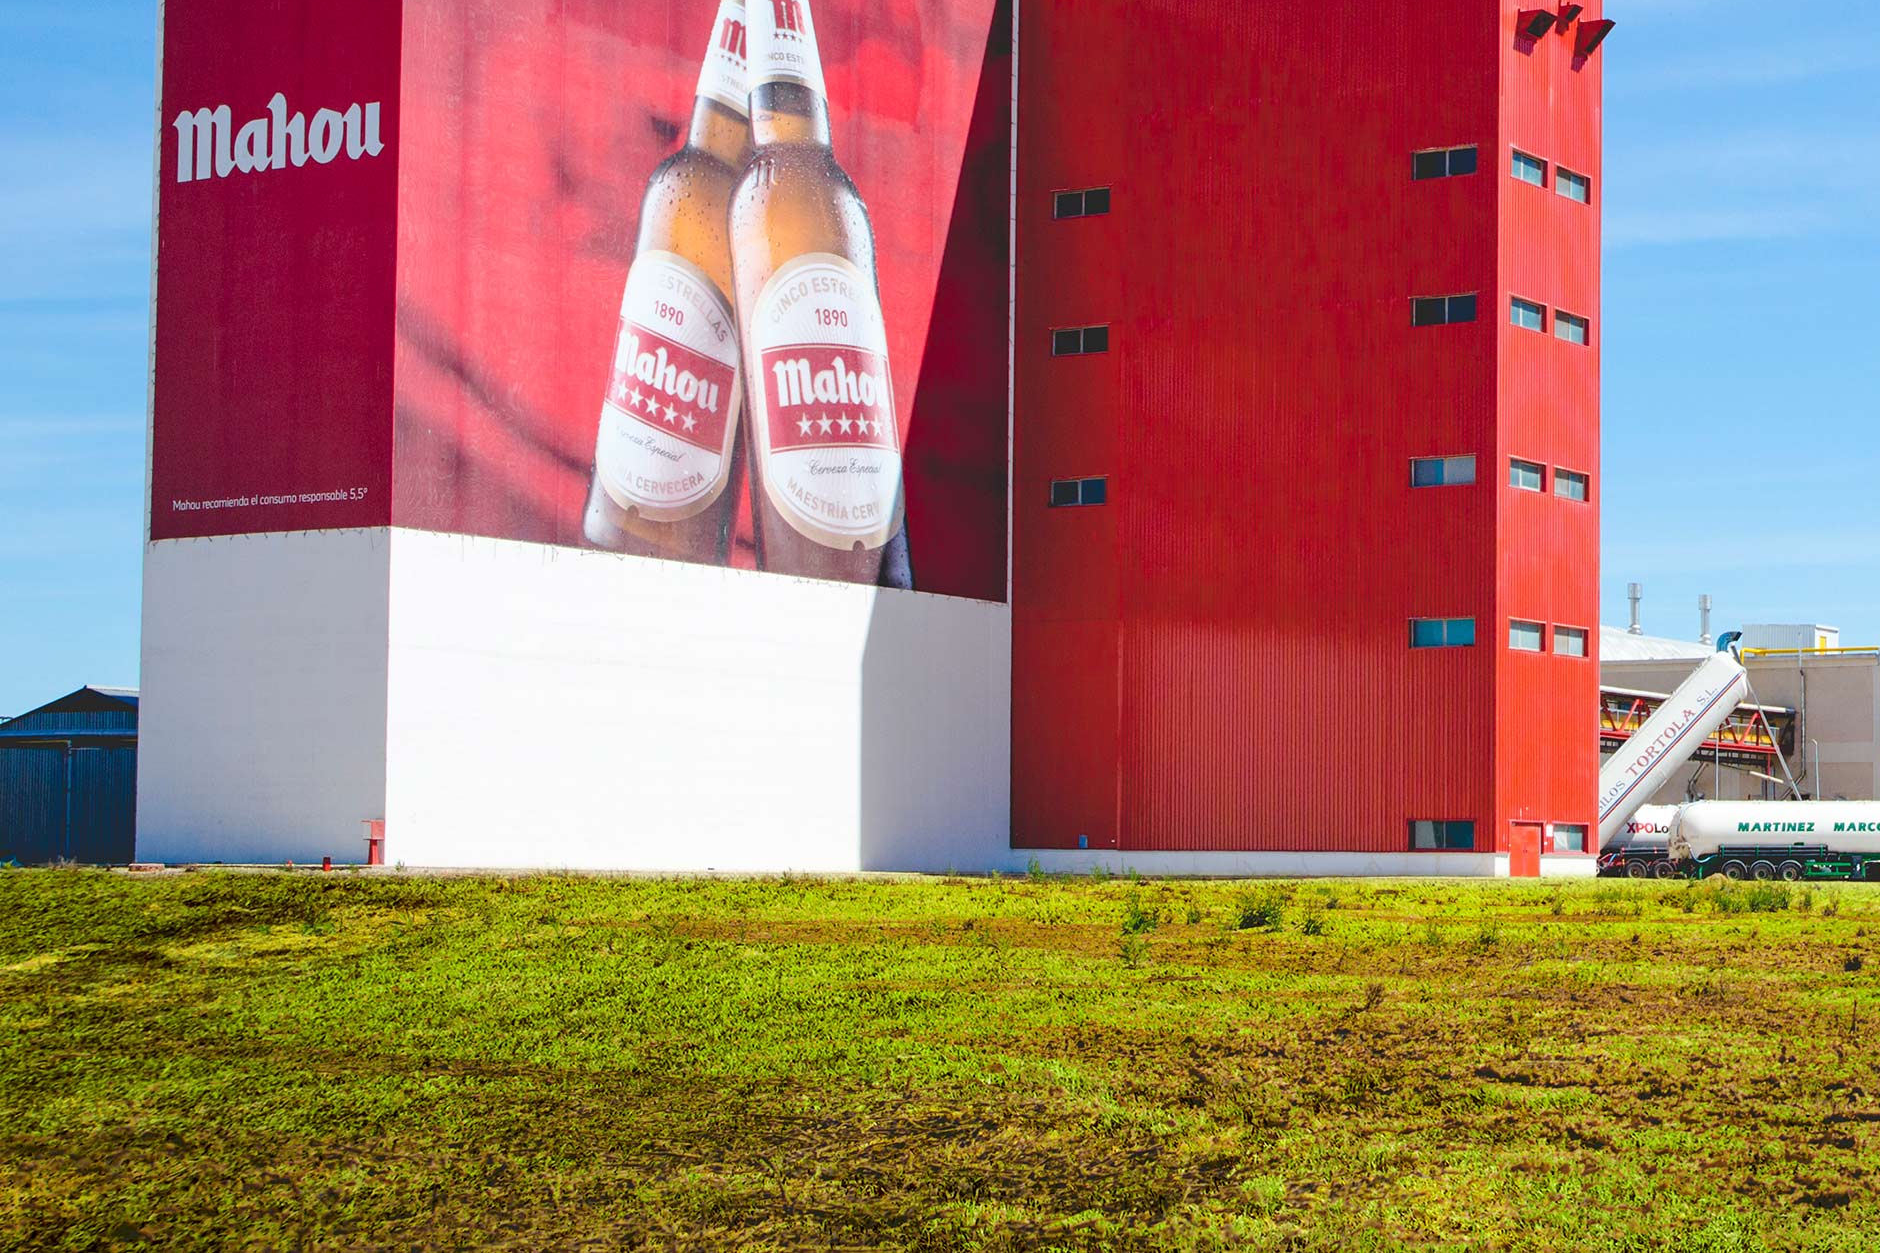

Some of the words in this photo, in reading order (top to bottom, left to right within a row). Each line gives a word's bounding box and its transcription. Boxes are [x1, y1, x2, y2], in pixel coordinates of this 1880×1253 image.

[172, 92, 385, 183] Mahou
[654, 299, 684, 326] 1890
[770, 281, 809, 323] CINCO
[815, 307, 848, 328] 1890
[614, 328, 719, 413] Mahou
[808, 459, 848, 476] Cerveza
[635, 472, 705, 495] CERVECERA
[172, 498, 201, 512] Mahou
[201, 496, 250, 510] recomienda
[250, 494, 259, 506] el
[259, 492, 297, 506] consumo
[298, 488, 348, 504] responsable
[786, 477, 849, 520] MAESTRÍA
[1624, 708, 1696, 778] TORTOLA
[1696, 686, 1719, 706] S.L.
[1737, 821, 1815, 833] MARTINEZ
